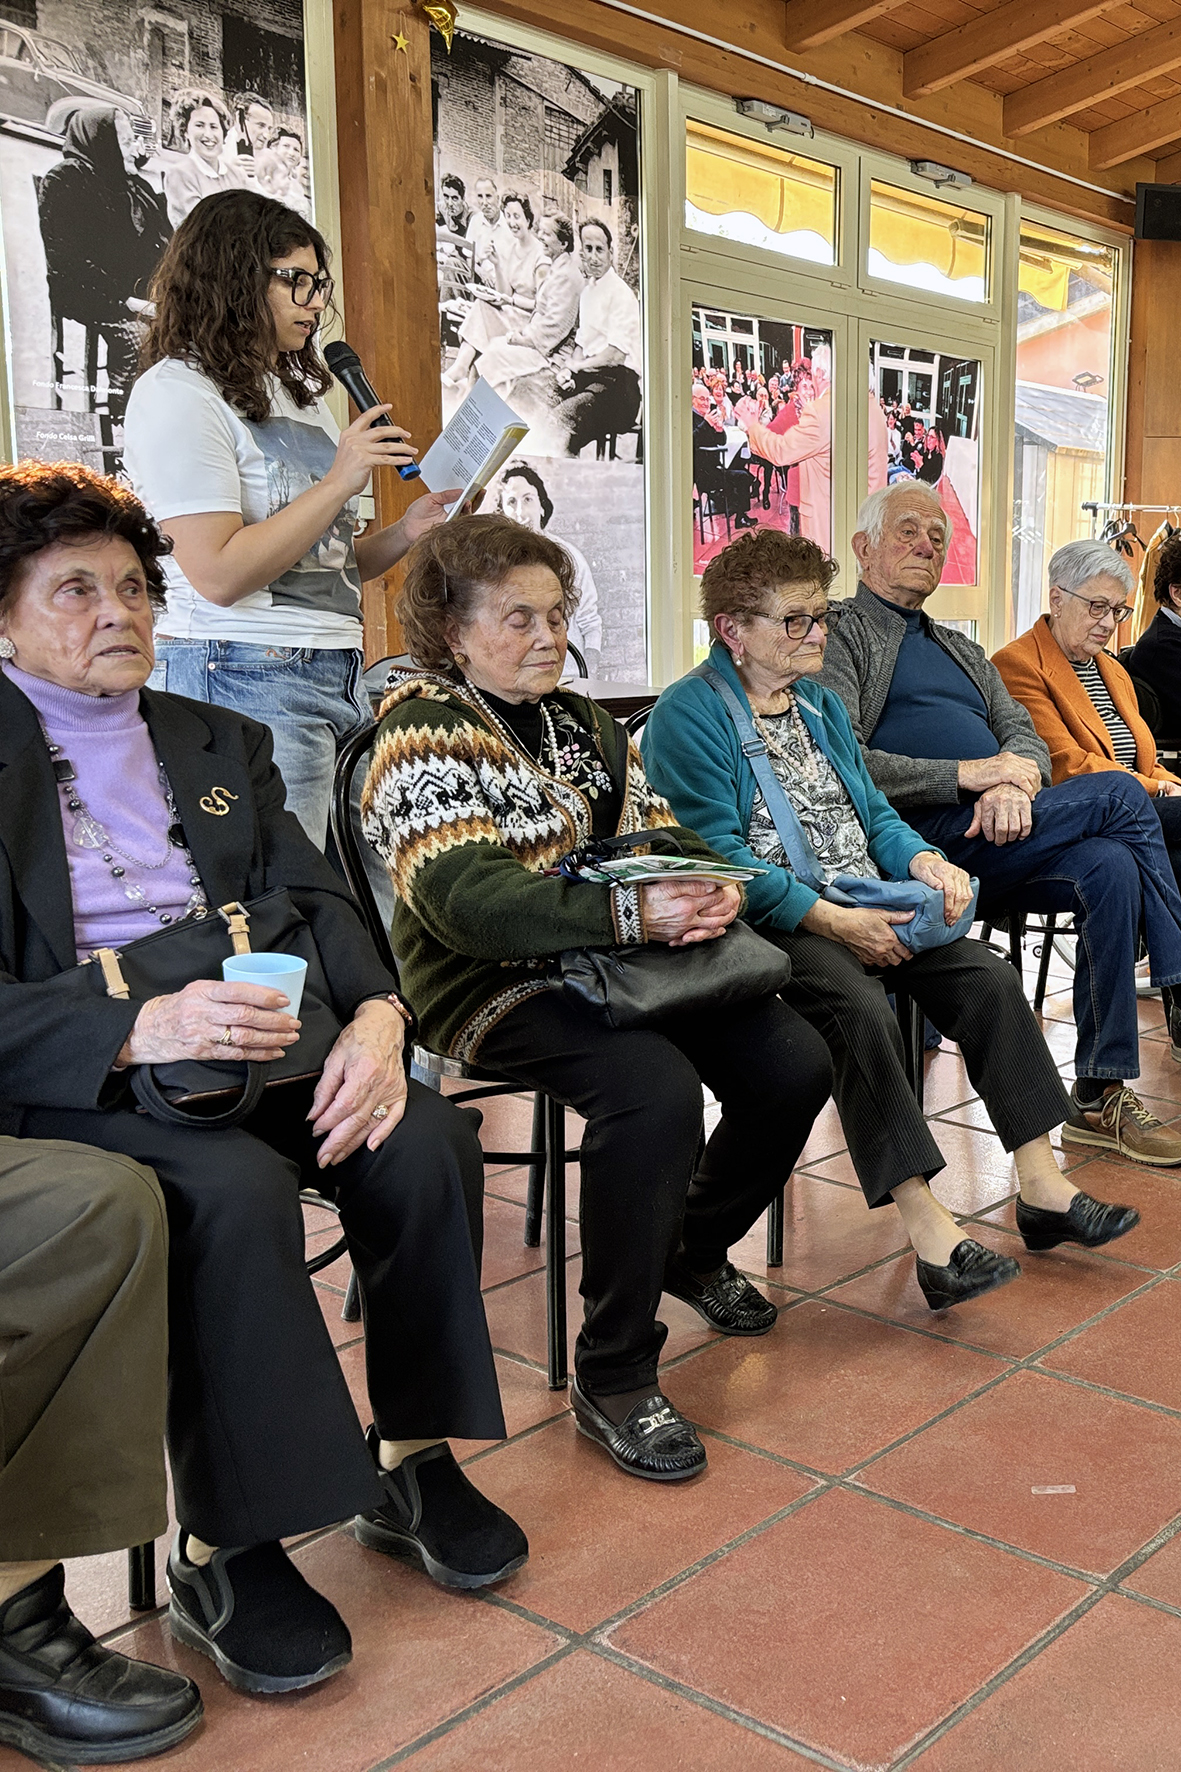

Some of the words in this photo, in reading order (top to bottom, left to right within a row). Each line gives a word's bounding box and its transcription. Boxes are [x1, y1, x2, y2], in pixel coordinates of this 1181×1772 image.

[32, 379, 54, 389] Fondo
[55, 382, 90, 392] Francesca
[36, 431, 58, 441] Fondo
